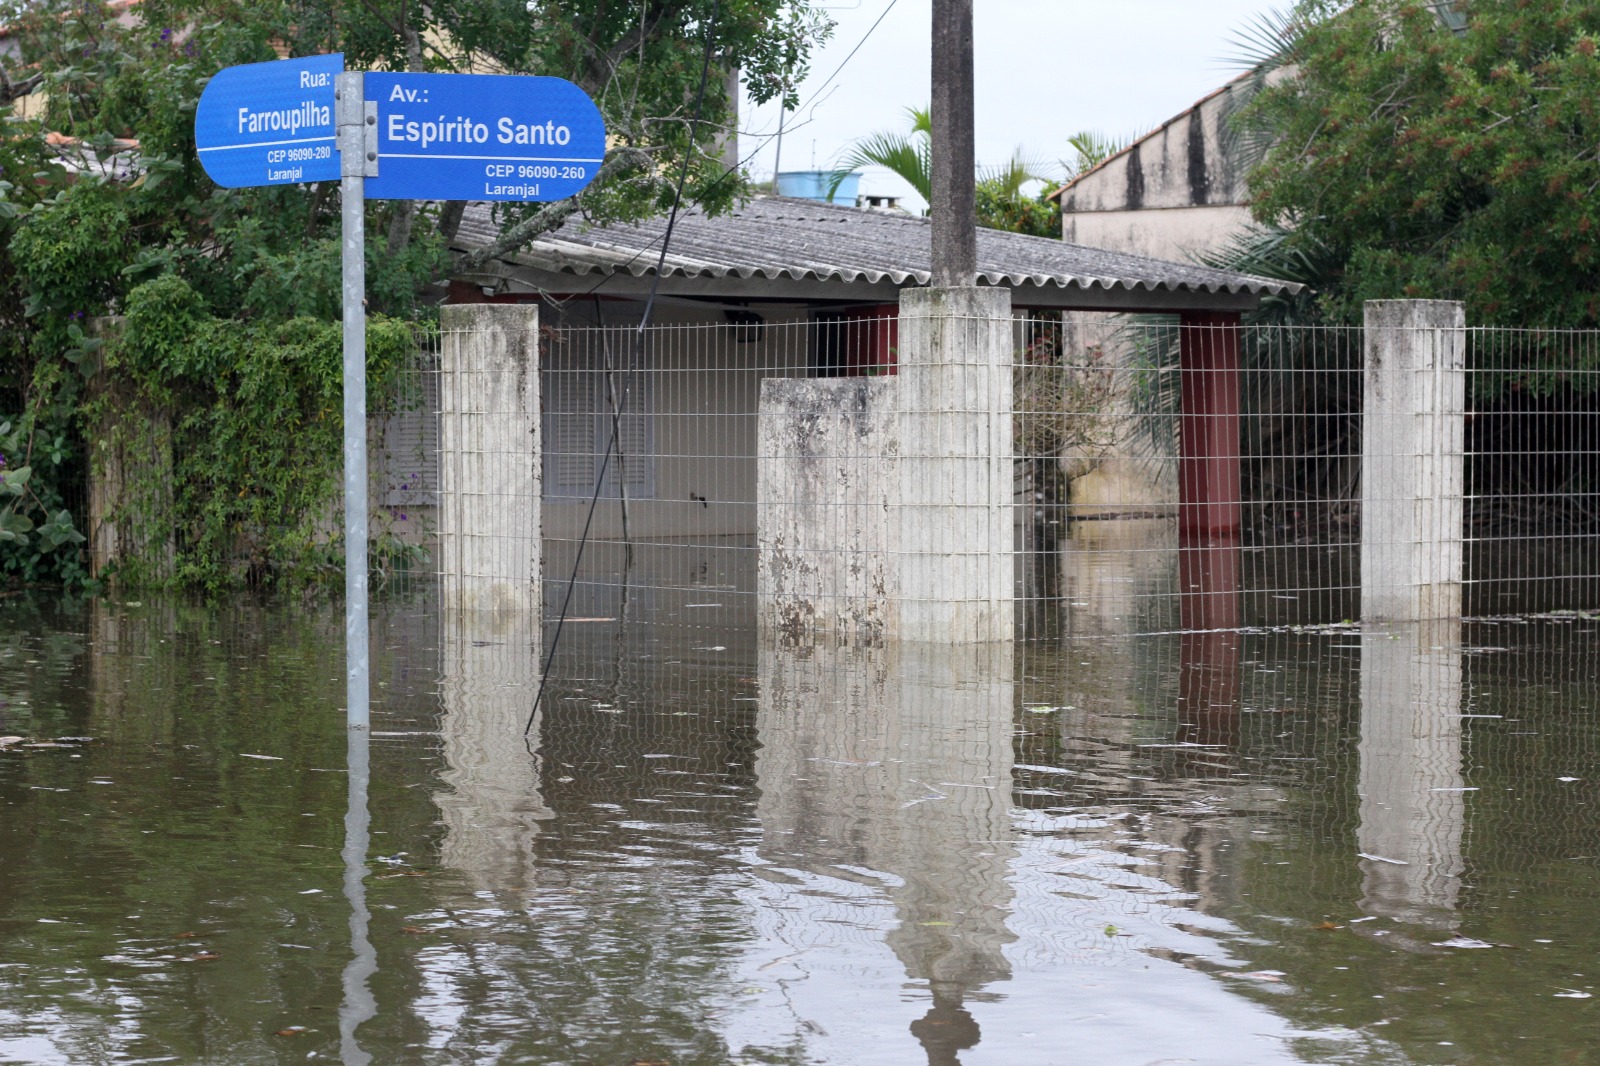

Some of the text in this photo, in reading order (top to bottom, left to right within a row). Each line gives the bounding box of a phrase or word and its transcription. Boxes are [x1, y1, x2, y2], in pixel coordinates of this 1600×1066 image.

[300, 70, 331, 88] Rua:
[389, 84, 429, 103] Av.:
[238, 100, 330, 135] Farroupilha
[388, 114, 571, 148] Espírito Santo
[267, 146, 331, 163] CEP 96090-280
[268, 166, 303, 182] Laranjal
[485, 164, 586, 179] CEP 96090-260
[485, 183, 540, 198] Laranjal
